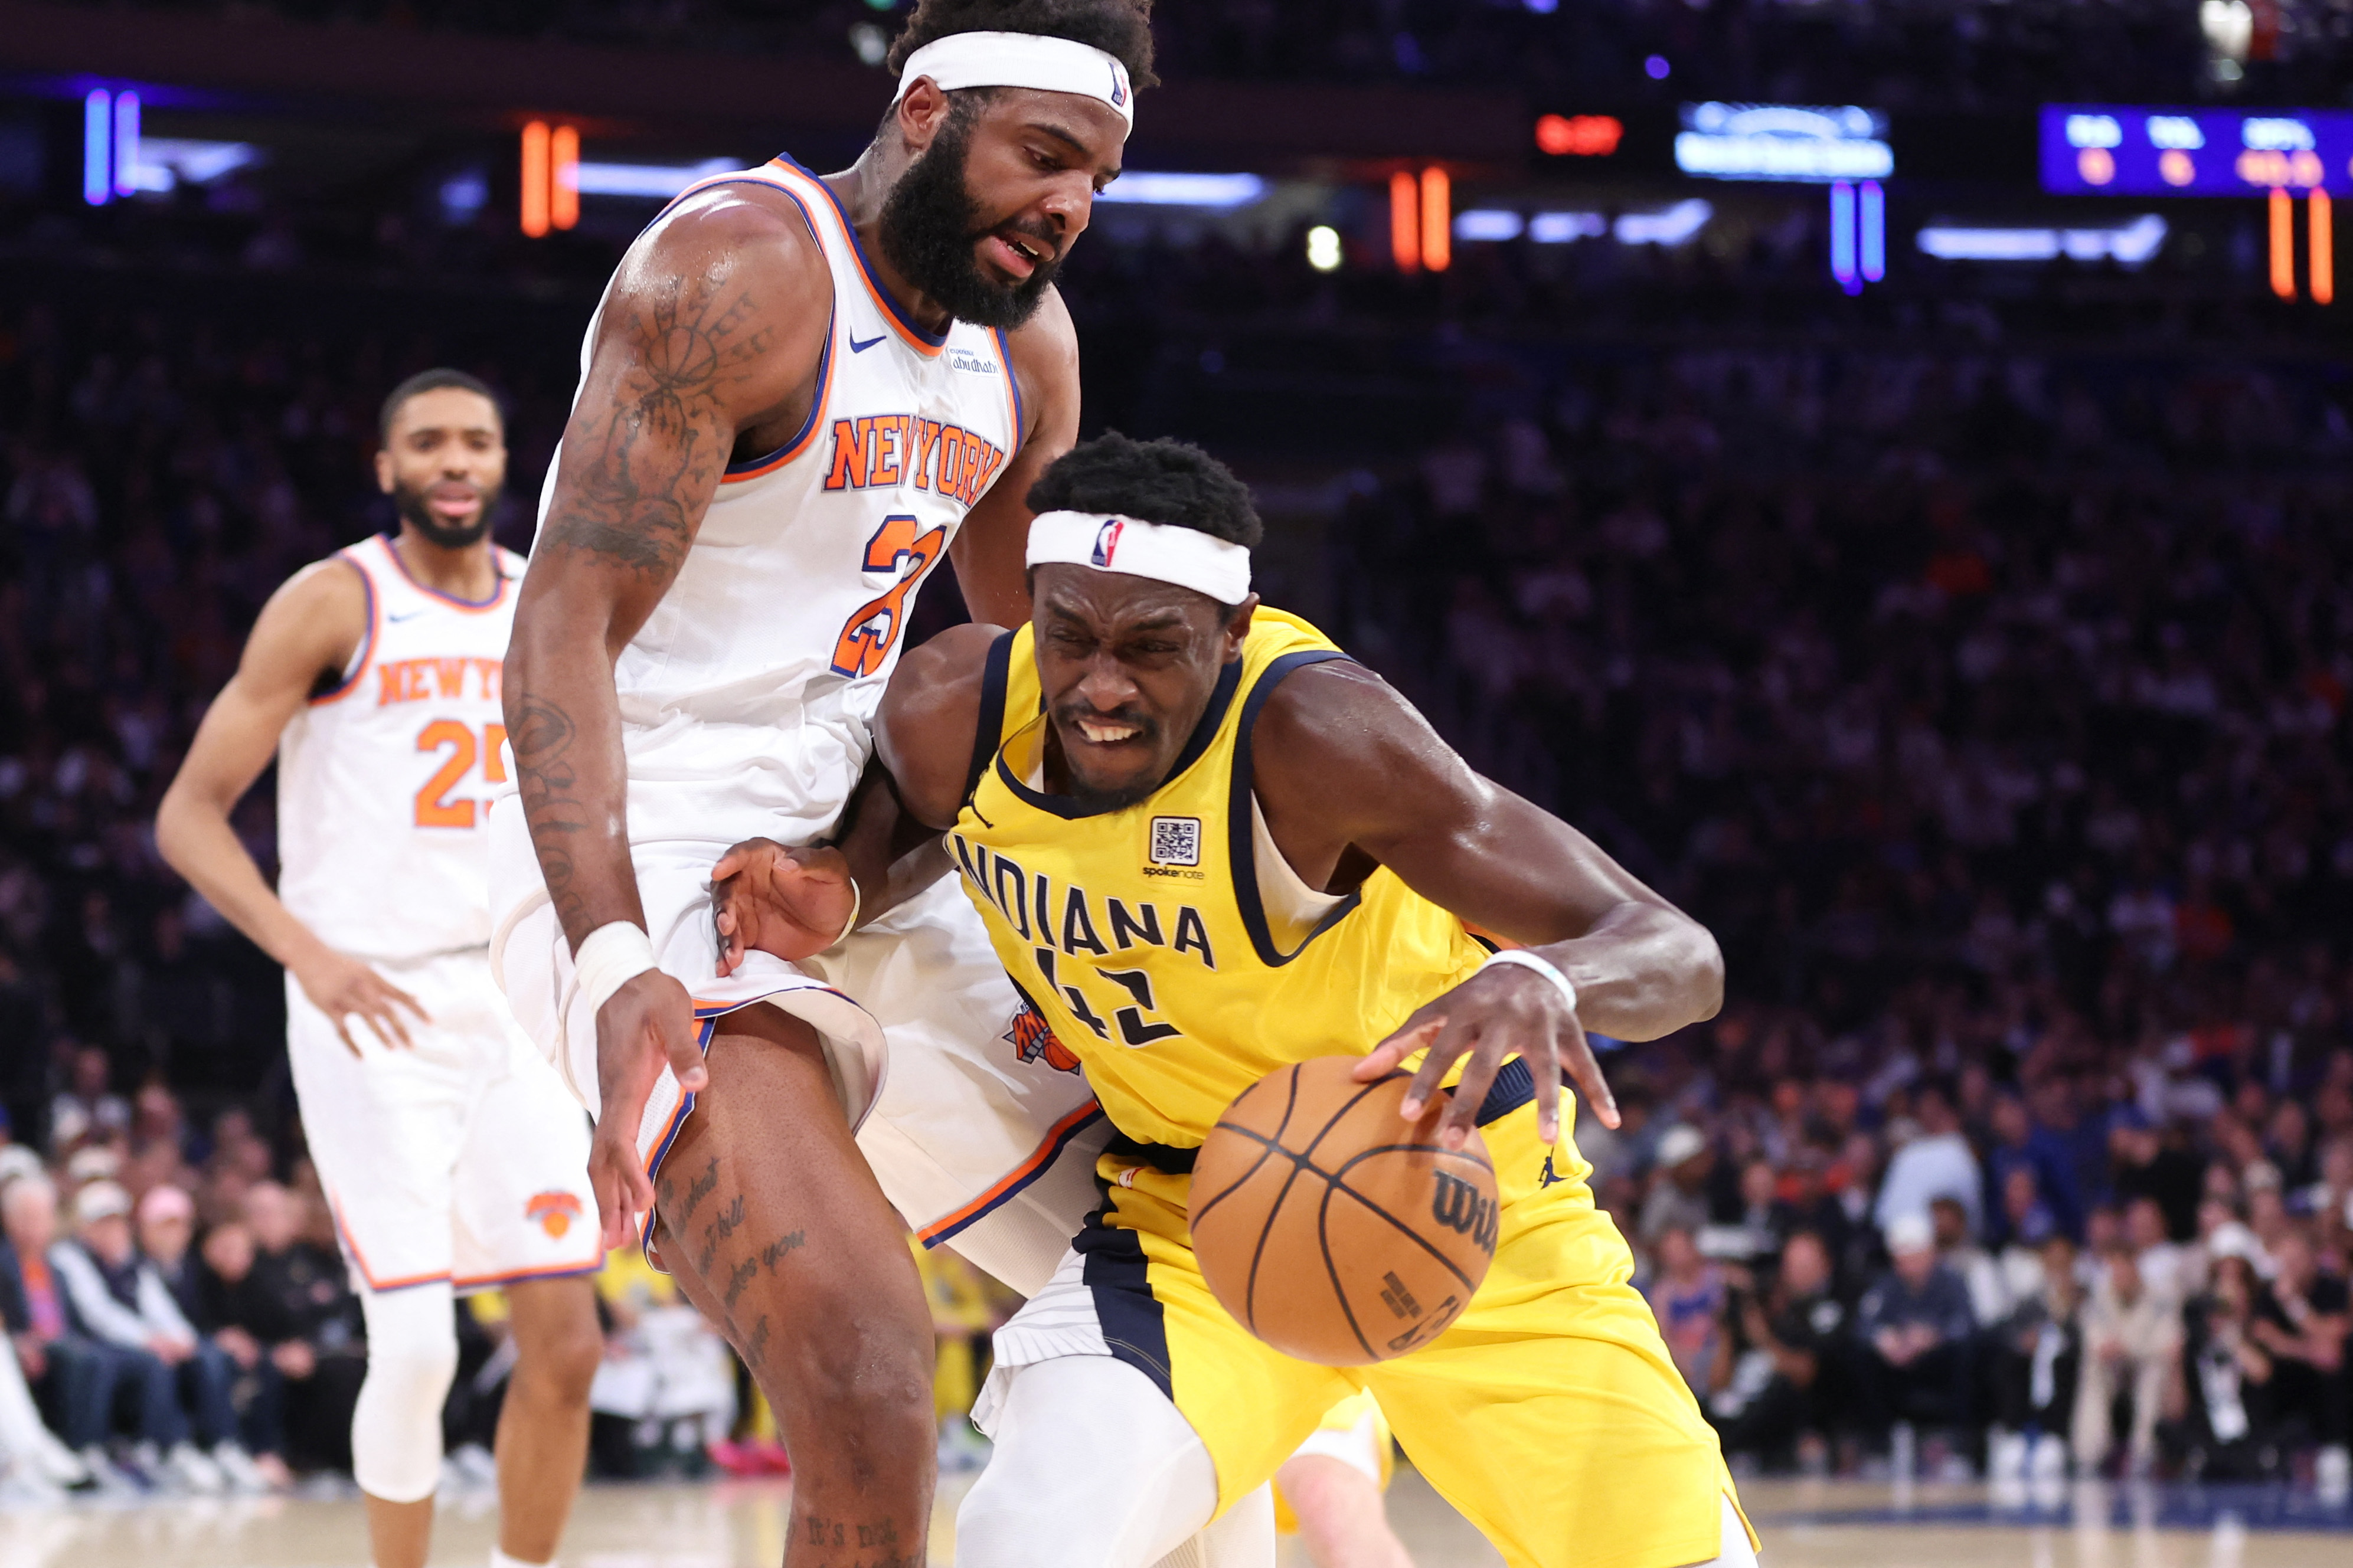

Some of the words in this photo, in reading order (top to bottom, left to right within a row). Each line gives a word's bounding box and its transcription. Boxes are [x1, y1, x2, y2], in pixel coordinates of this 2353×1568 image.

[913, 417, 1004, 510] YORK
[378, 657, 467, 706] NEW
[1142, 866, 1205, 880] spokenote
[1033, 946, 1187, 1049] 42
